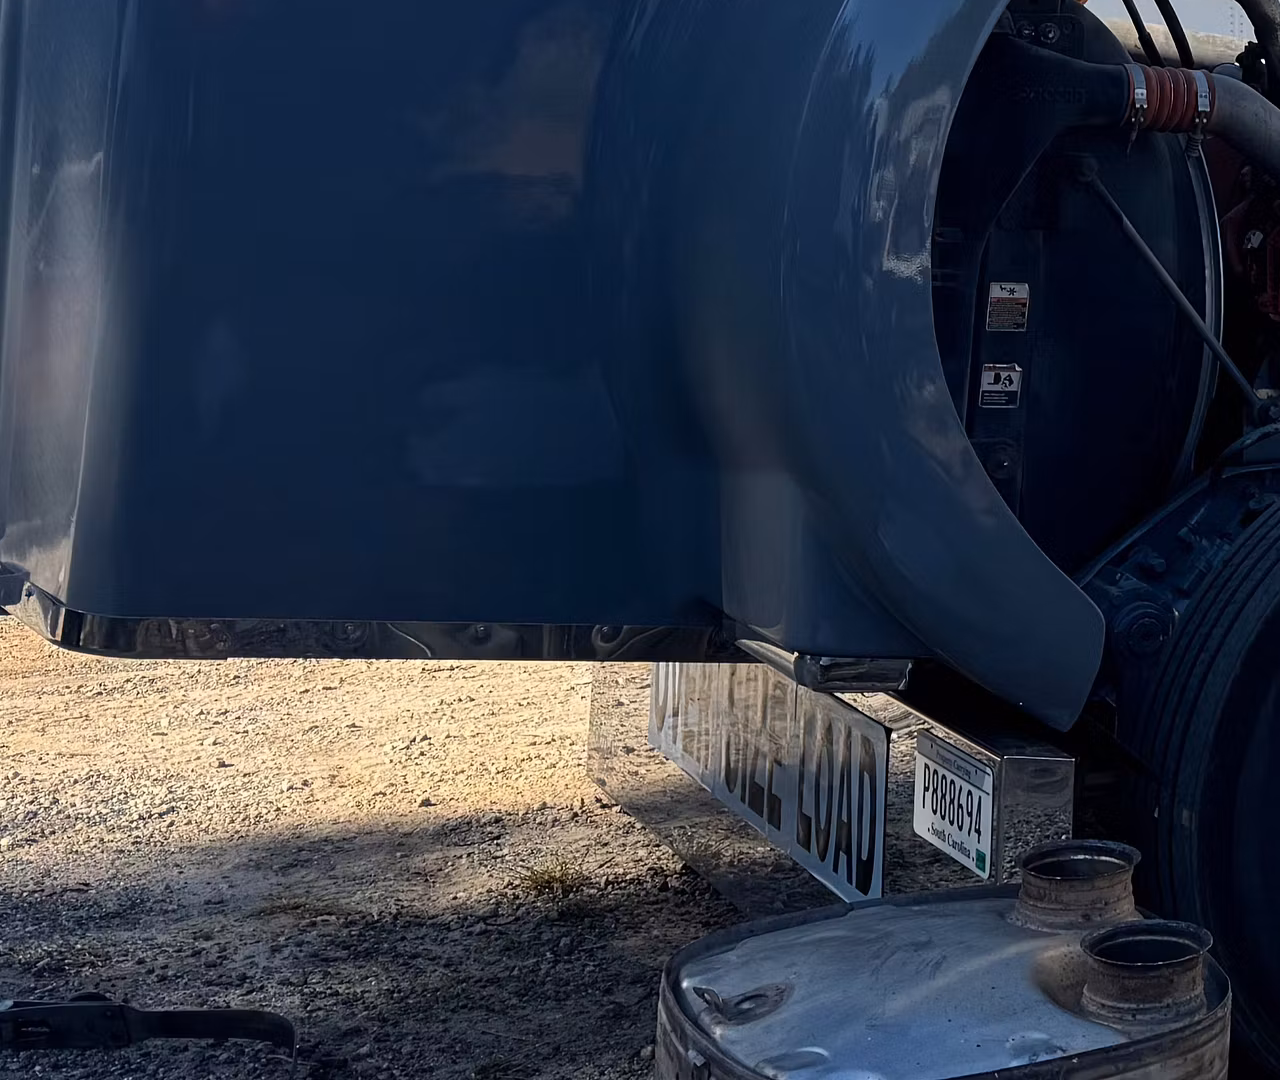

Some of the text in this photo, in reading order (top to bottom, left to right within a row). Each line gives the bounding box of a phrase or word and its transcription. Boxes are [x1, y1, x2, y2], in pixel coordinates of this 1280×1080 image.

[796, 707, 878, 897] LOAD
[922, 762, 982, 844] P888694
[930, 822, 971, 859] South Carolina
